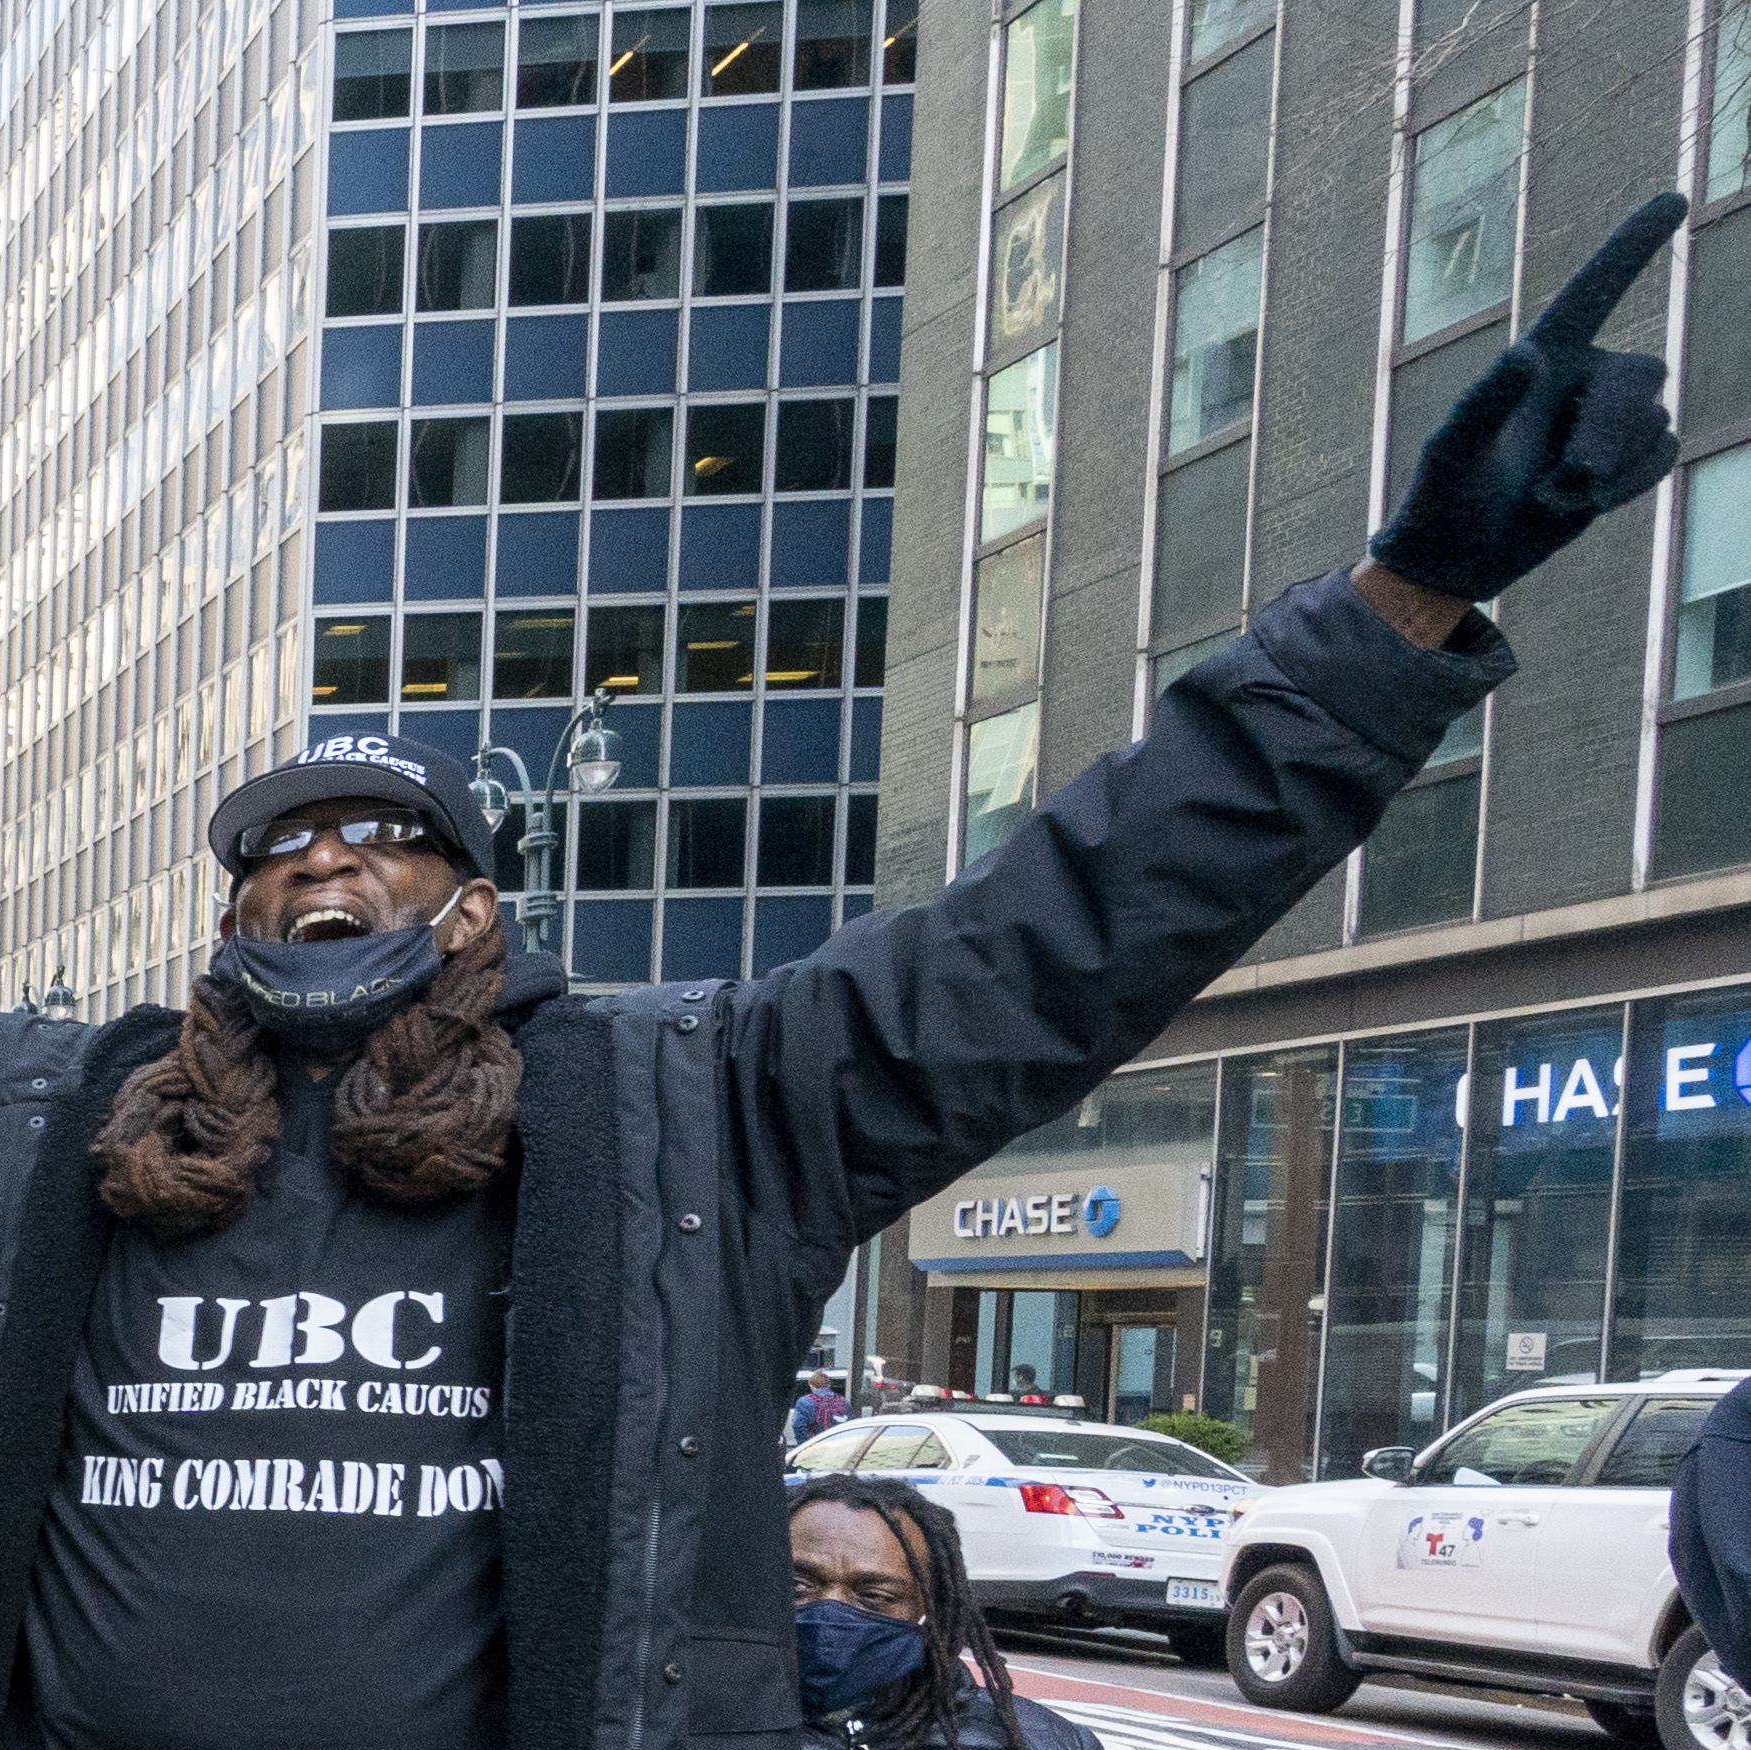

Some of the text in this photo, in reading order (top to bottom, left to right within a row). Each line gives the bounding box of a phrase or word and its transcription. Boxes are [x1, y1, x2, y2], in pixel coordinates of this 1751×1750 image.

[298, 736, 389, 764] UBC
[953, 1193, 1076, 1239] CHASE
[156, 1290, 445, 1371] UBC
[107, 1378, 491, 1418] UNIFIED BLACK CAUCUS
[80, 1455, 165, 1509] KING
[172, 1458, 405, 1517] COMRADE
[1160, 1478, 1248, 1497] @NYPD13PCT
[1135, 1523, 1222, 1539] POLI
[1153, 1513, 1225, 1528] NYP
